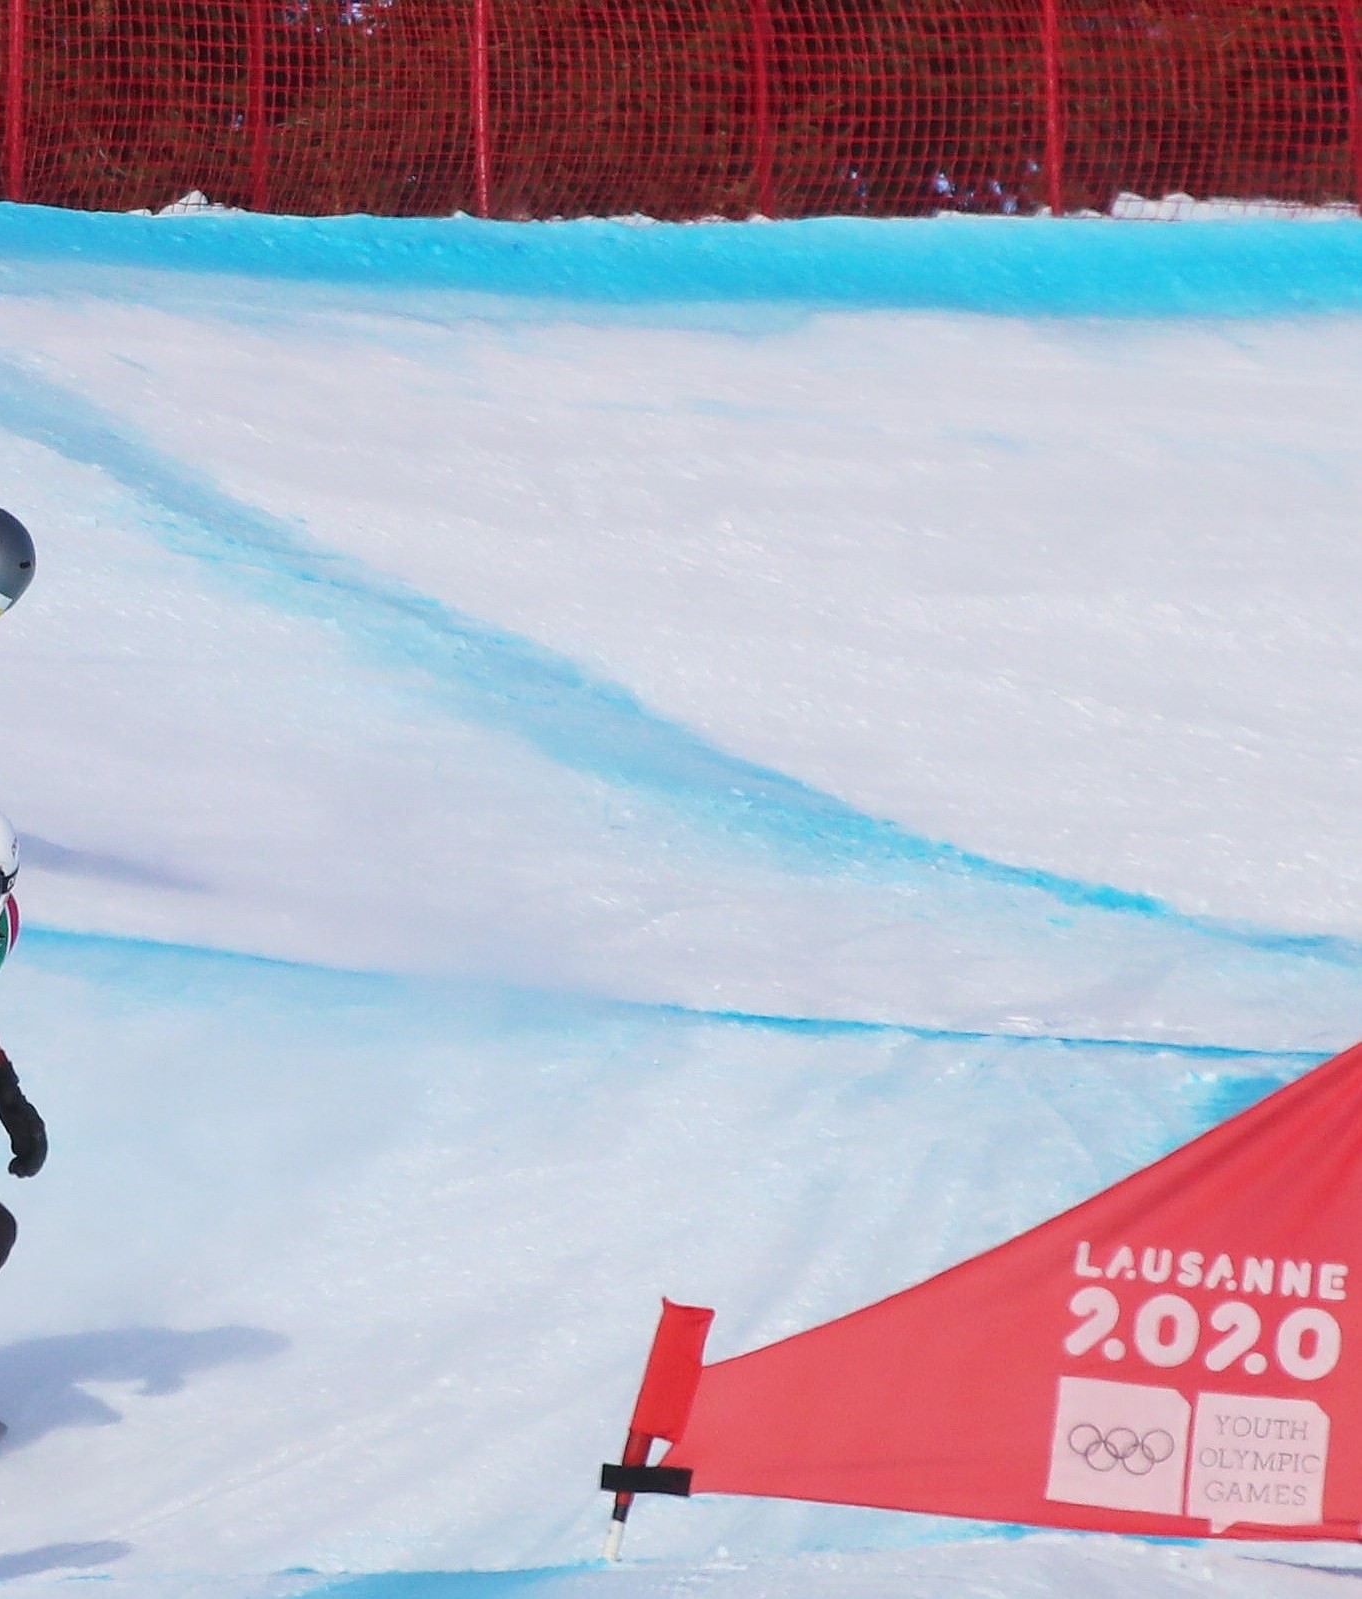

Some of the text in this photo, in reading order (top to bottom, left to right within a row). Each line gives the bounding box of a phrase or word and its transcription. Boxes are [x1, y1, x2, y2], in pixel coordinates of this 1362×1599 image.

[1074, 1241, 1348, 1300] LAUSANNE
[1215, 1414, 1309, 1441] YOUTH
[1198, 1446, 1321, 1474] OLYMPIC
[1204, 1480, 1309, 1506] GAMES
